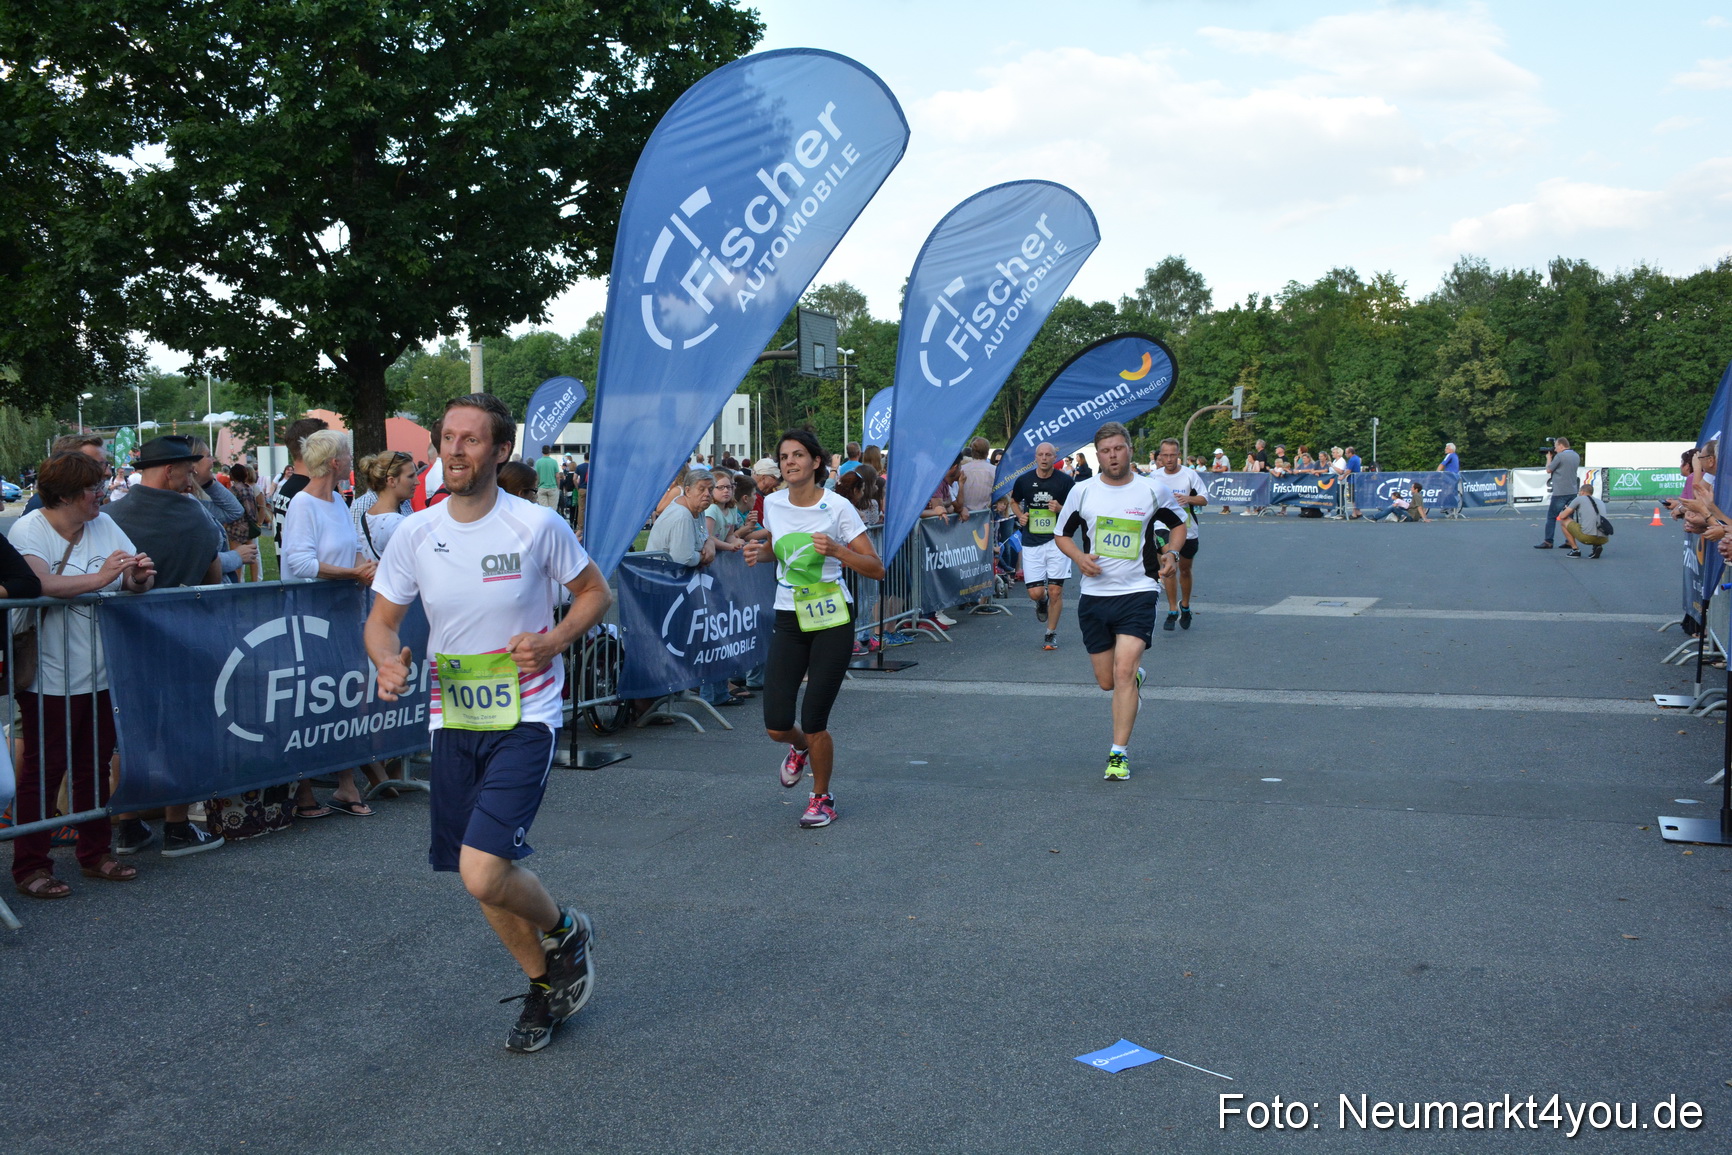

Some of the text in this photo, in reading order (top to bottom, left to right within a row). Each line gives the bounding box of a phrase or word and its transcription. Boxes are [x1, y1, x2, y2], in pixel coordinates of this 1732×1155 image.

[680, 101, 842, 314] Fischer
[736, 142, 860, 313] AUTOMOBILE
[945, 212, 1053, 362] Fischer
[984, 240, 1067, 359] AUTOMOBILE
[538, 386, 574, 433] Fischer
[1093, 375, 1168, 420] Druck und Medien
[550, 395, 578, 433] AUTOMOBILE
[1023, 382, 1131, 447] Frischmann
[1216, 484, 1255, 496] Fischer
[1273, 482, 1319, 493] Frischmann
[1388, 486, 1442, 497] Fiser
[1463, 481, 1497, 492] Frischmann
[1614, 472, 1642, 487] AOK
[1034, 518, 1051, 527] 169
[1103, 533, 1131, 549] 400
[925, 543, 979, 572] Frischmann
[686, 600, 761, 645] Fischer
[805, 598, 837, 618] 115
[693, 635, 757, 665] AUTOMOBILE
[447, 683, 512, 709] 1005
[283, 703, 426, 753] AUTOMOBILE
